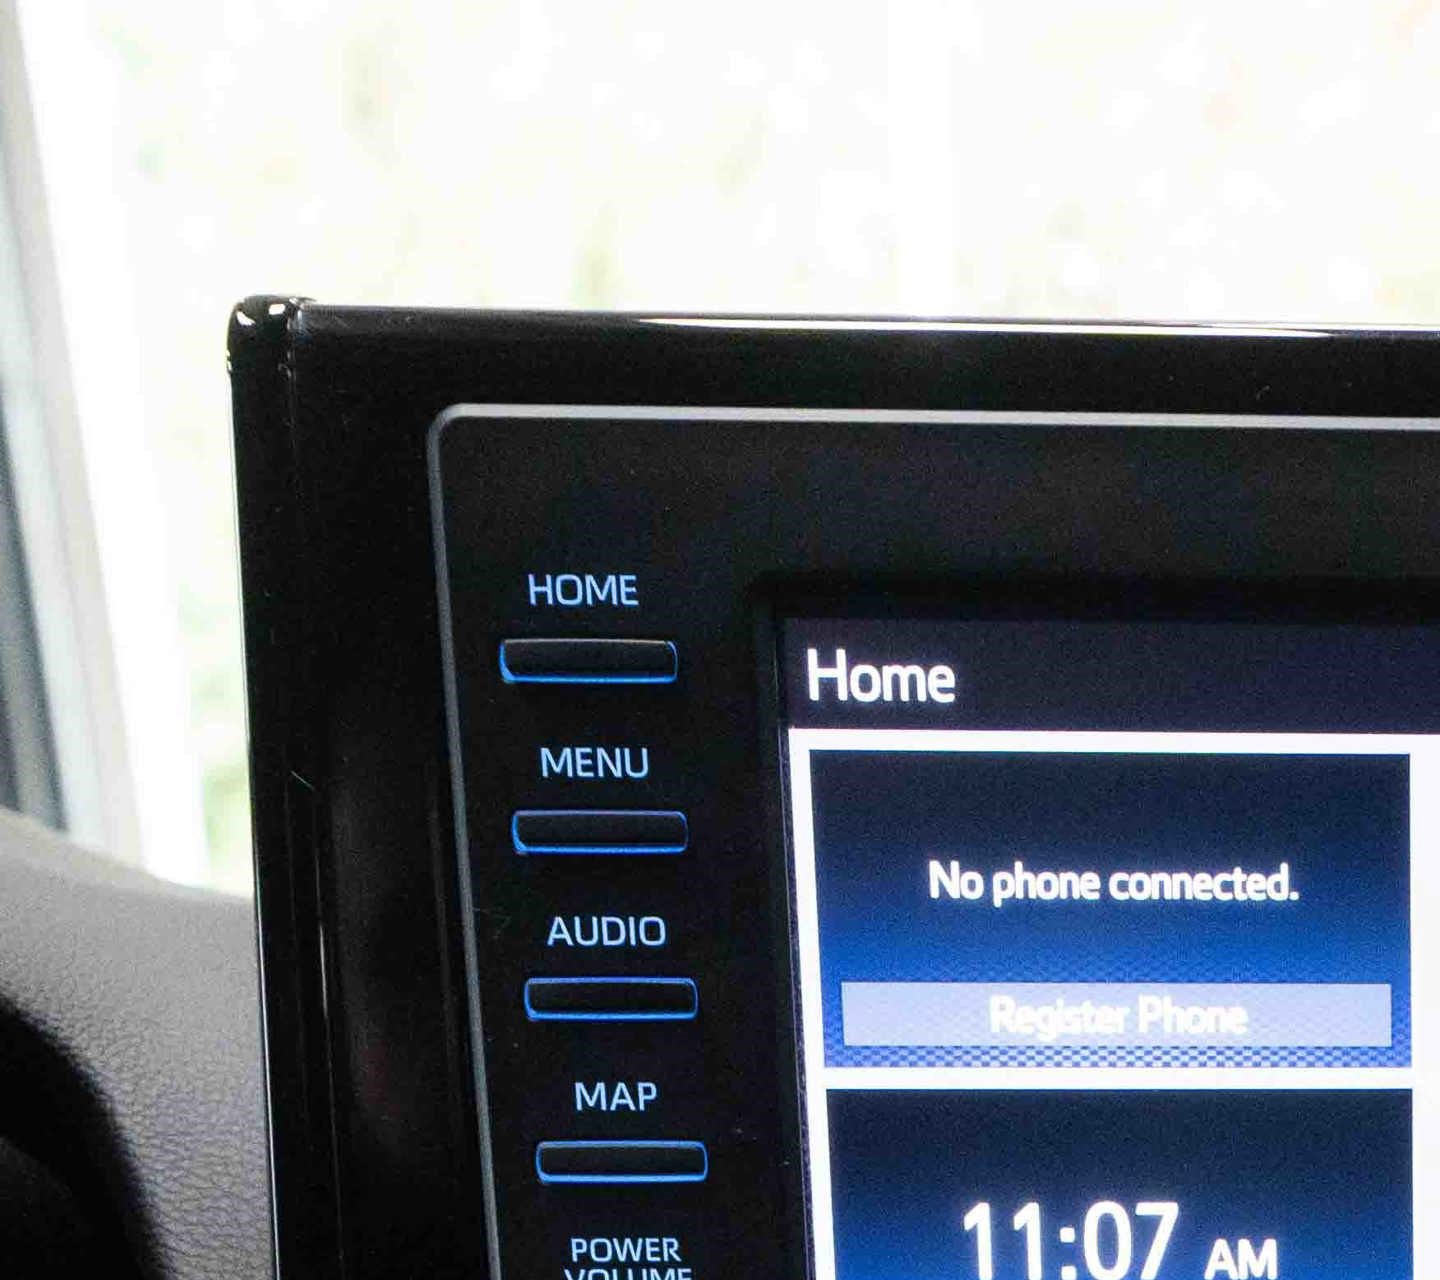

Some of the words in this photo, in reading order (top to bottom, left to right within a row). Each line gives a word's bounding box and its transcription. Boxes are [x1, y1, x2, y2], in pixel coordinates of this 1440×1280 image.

[527, 573, 639, 606] HOME
[806, 647, 956, 704] Home
[540, 747, 649, 779] MENU
[928, 860, 985, 901] No
[991, 860, 1102, 909] phone
[1107, 862, 1300, 907] connected.
[547, 916, 666, 947] AUDIO
[990, 995, 1126, 1042] Register
[1137, 995, 1249, 1036] Phone
[574, 1081, 657, 1112] MAP
[570, 1237, 682, 1263] POWER
[1203, 1238, 1280, 1280] AM
